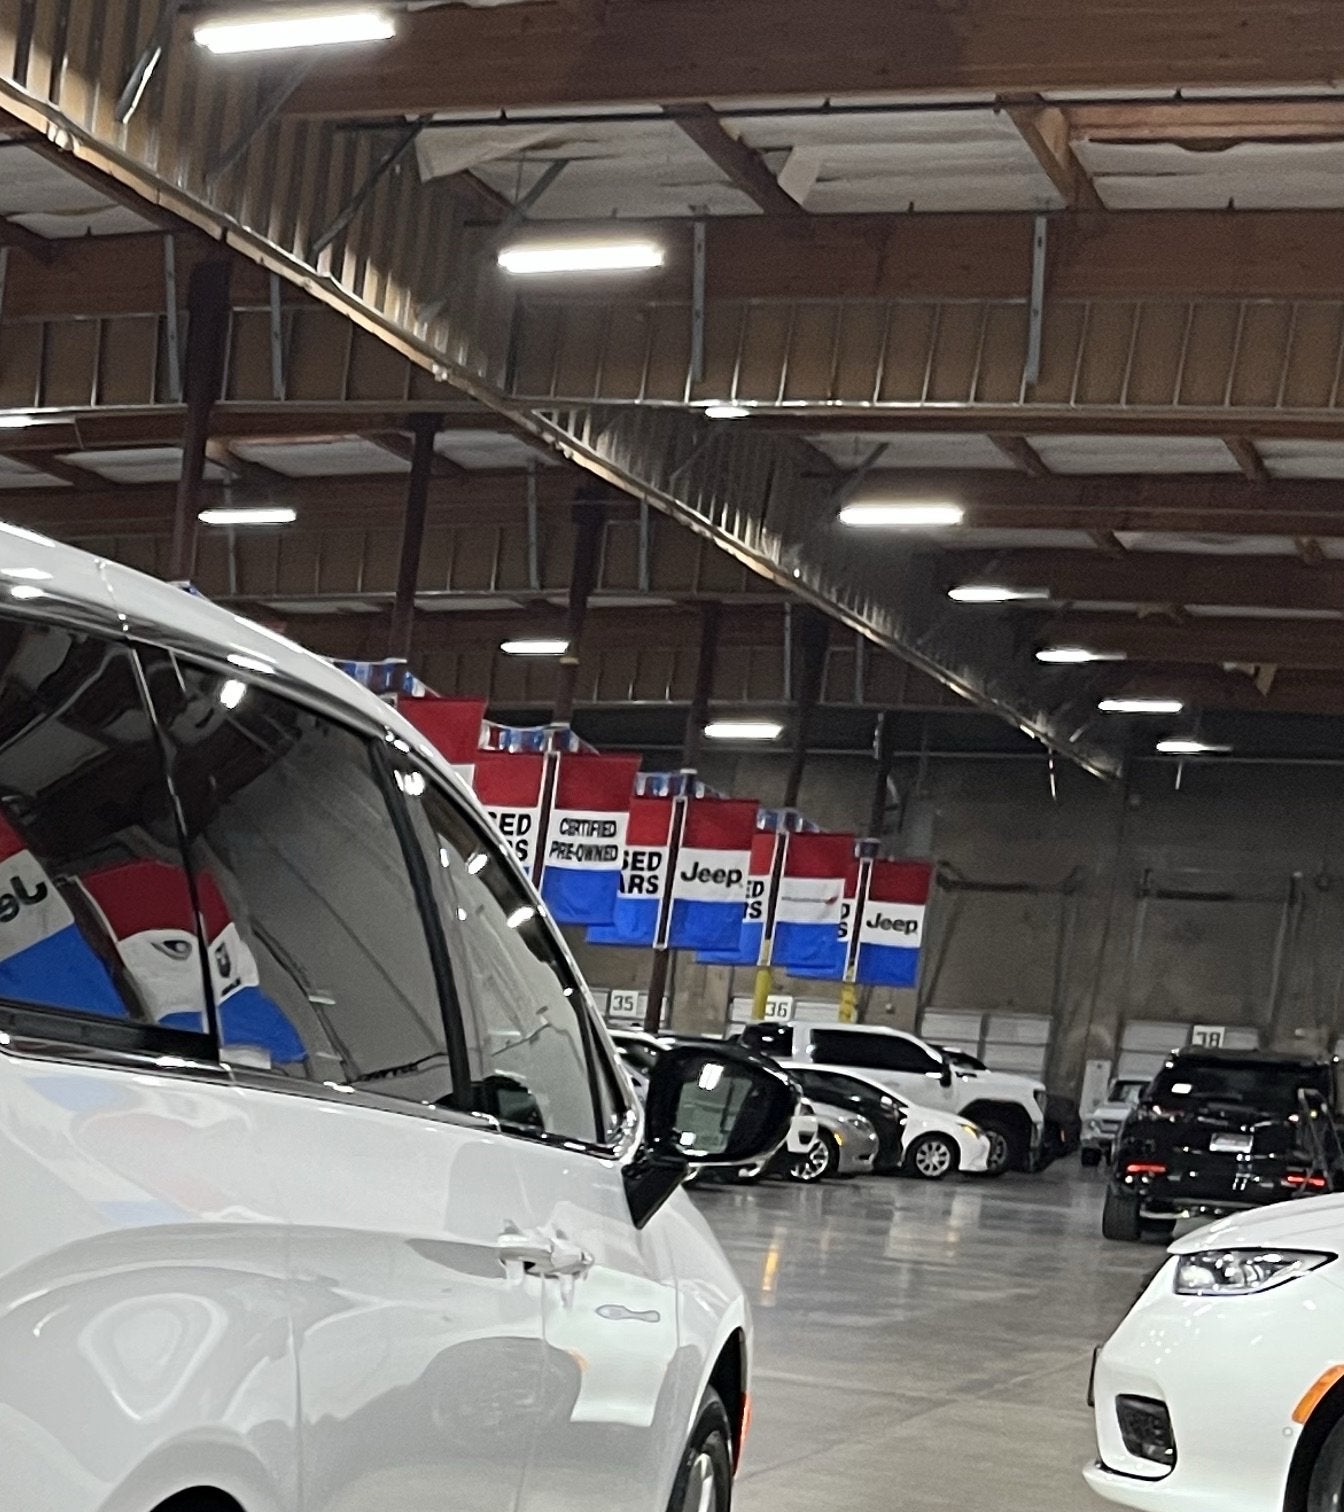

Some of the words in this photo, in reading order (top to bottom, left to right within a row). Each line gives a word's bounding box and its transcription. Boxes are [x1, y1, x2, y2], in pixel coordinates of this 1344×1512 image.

[488, 811, 531, 836] ED
[622, 851, 662, 872] SED
[620, 874, 659, 895] RS
[680, 861, 742, 888] Jeep
[866, 912, 918, 935] Jeep
[612, 994, 634, 1012] 35
[765, 1001, 787, 1018] 36
